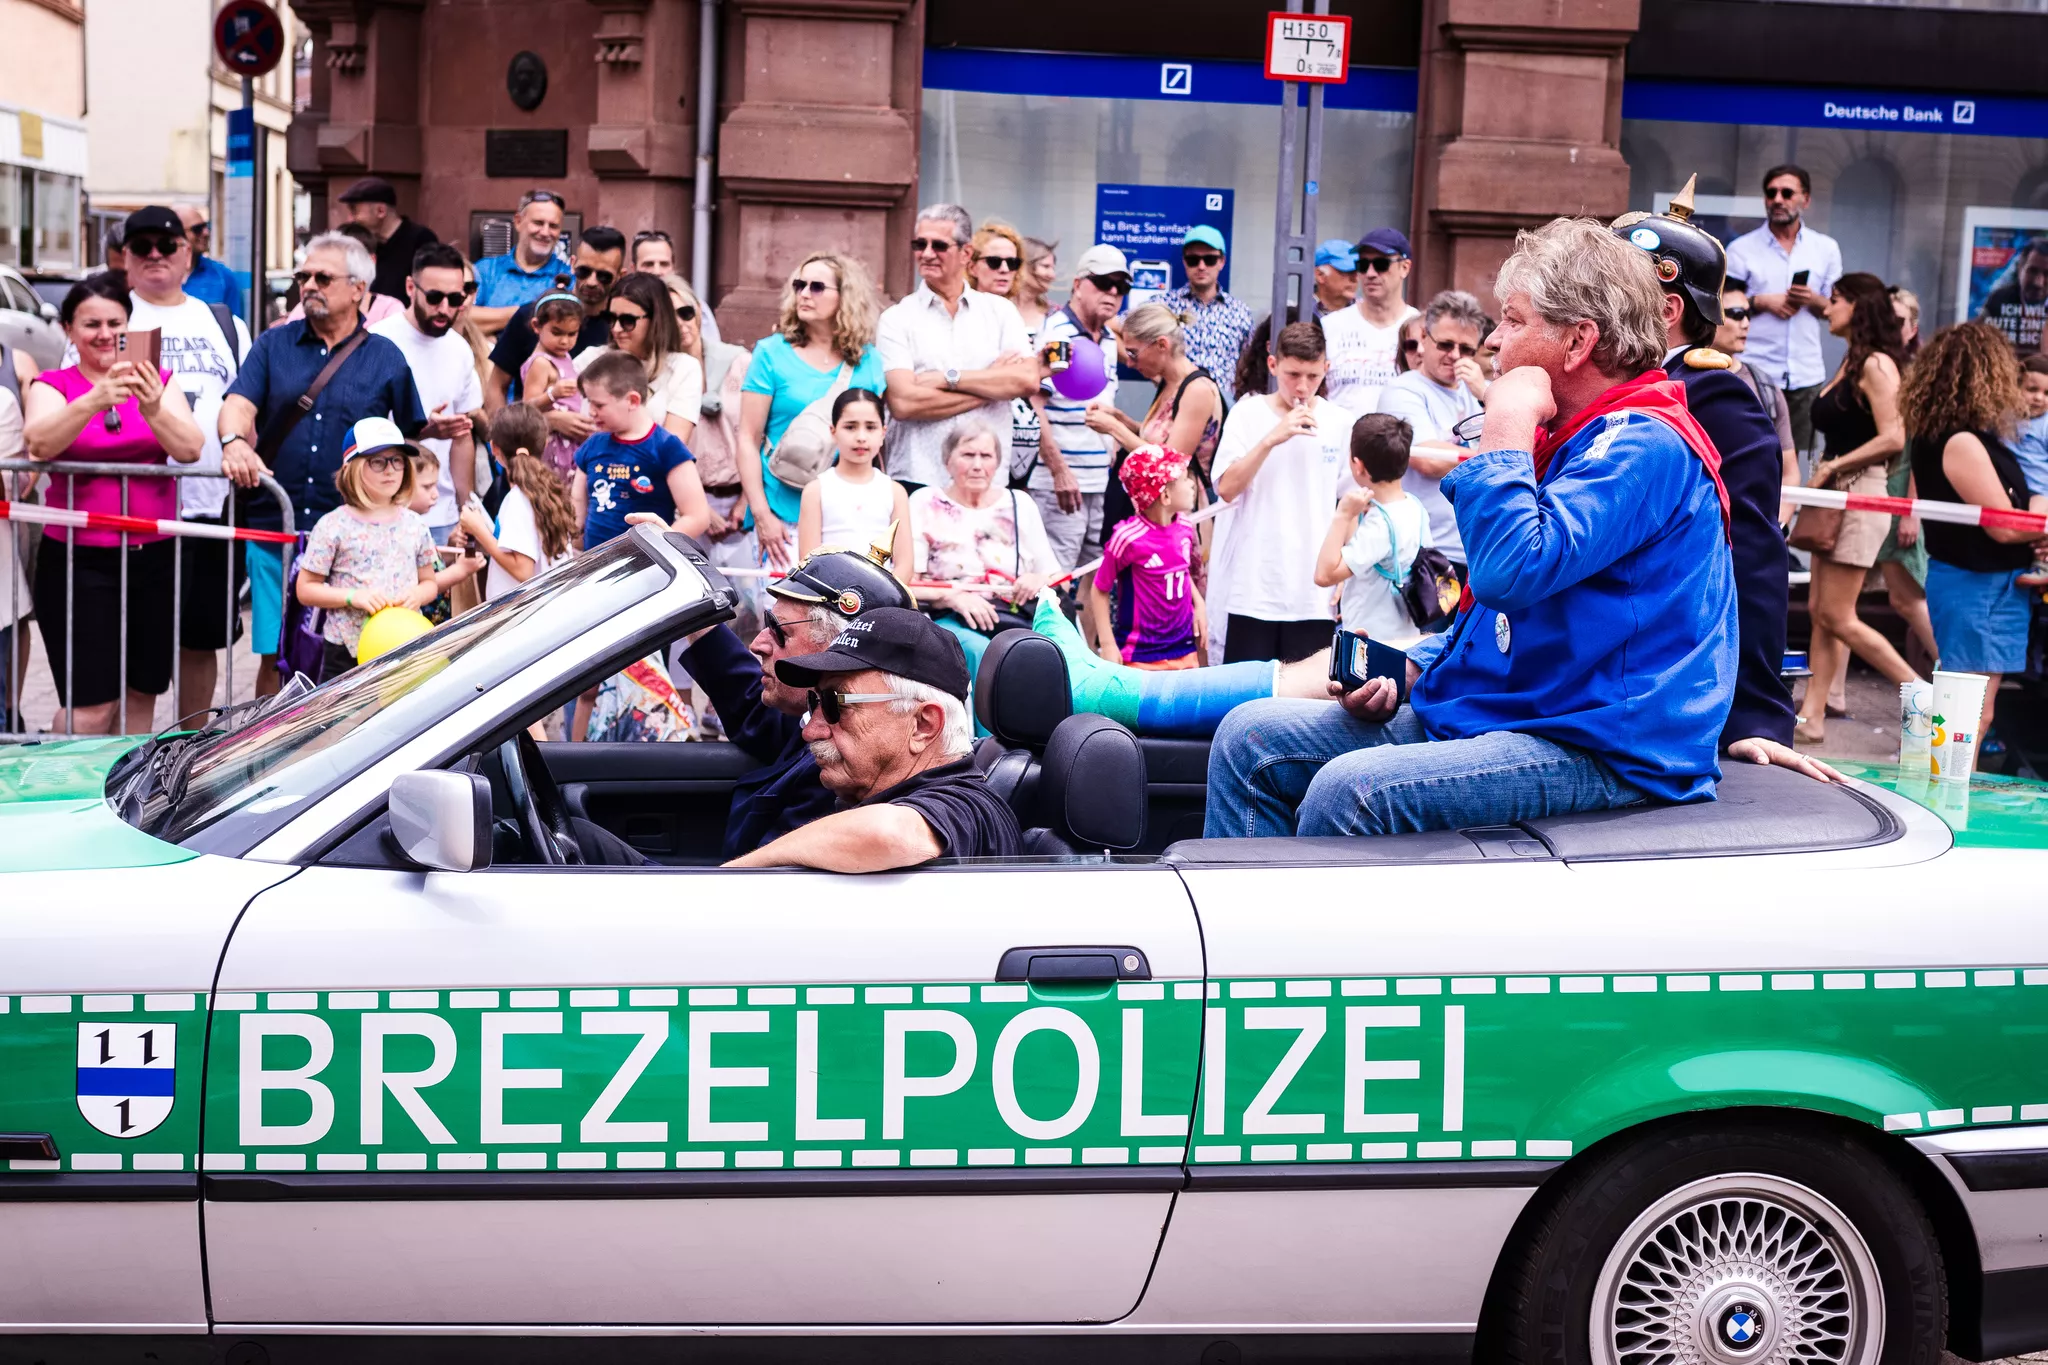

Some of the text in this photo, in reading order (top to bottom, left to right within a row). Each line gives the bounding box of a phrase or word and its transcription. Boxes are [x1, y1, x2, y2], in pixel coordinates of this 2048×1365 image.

[1283, 22, 1328, 38] H150
[1824, 102, 1943, 123] Deutsche Bank
[1102, 220, 1116, 232] Ba
[1143, 222, 1158, 233] So
[1101, 233, 1126, 243] kann
[1126, 234, 1169, 245] bezahlen
[2019, 331, 2040, 345] SIC
[160, 353, 229, 384] ULLS
[239, 1005, 1465, 1146] BREZELPOLIZEI
[1734, 1305, 1762, 1335] BMW
